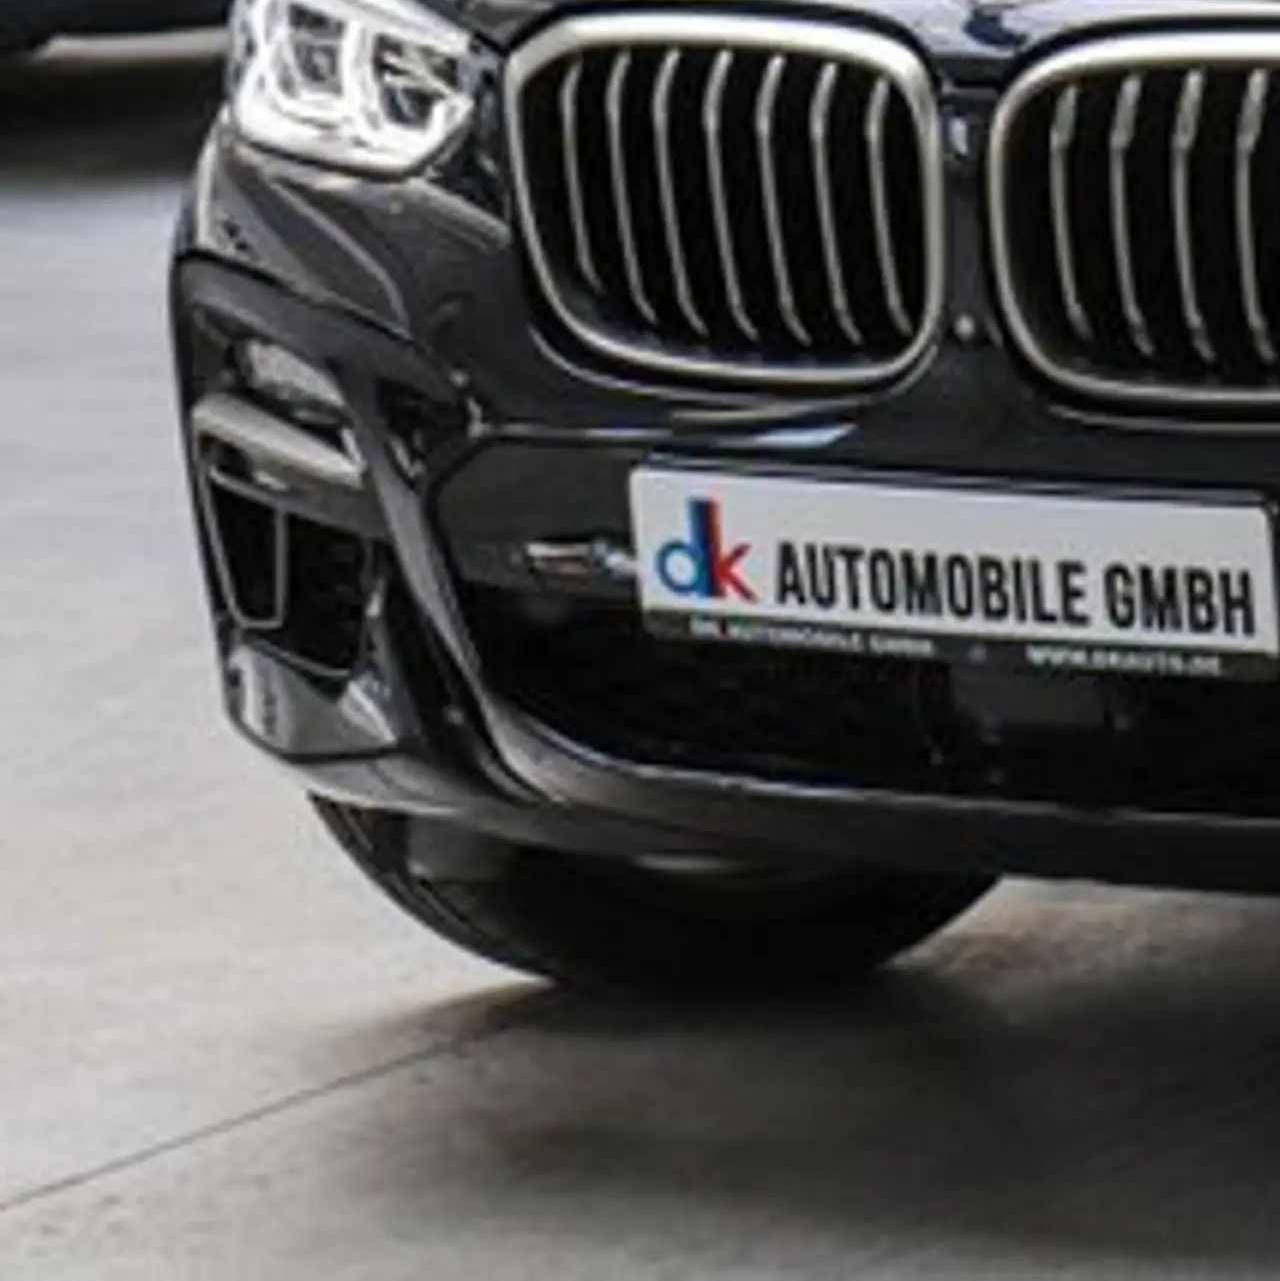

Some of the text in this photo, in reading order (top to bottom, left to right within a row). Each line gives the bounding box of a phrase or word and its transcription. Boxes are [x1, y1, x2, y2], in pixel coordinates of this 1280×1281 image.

[655, 496, 1256, 638] dk AUTOMOBILE GMBH
